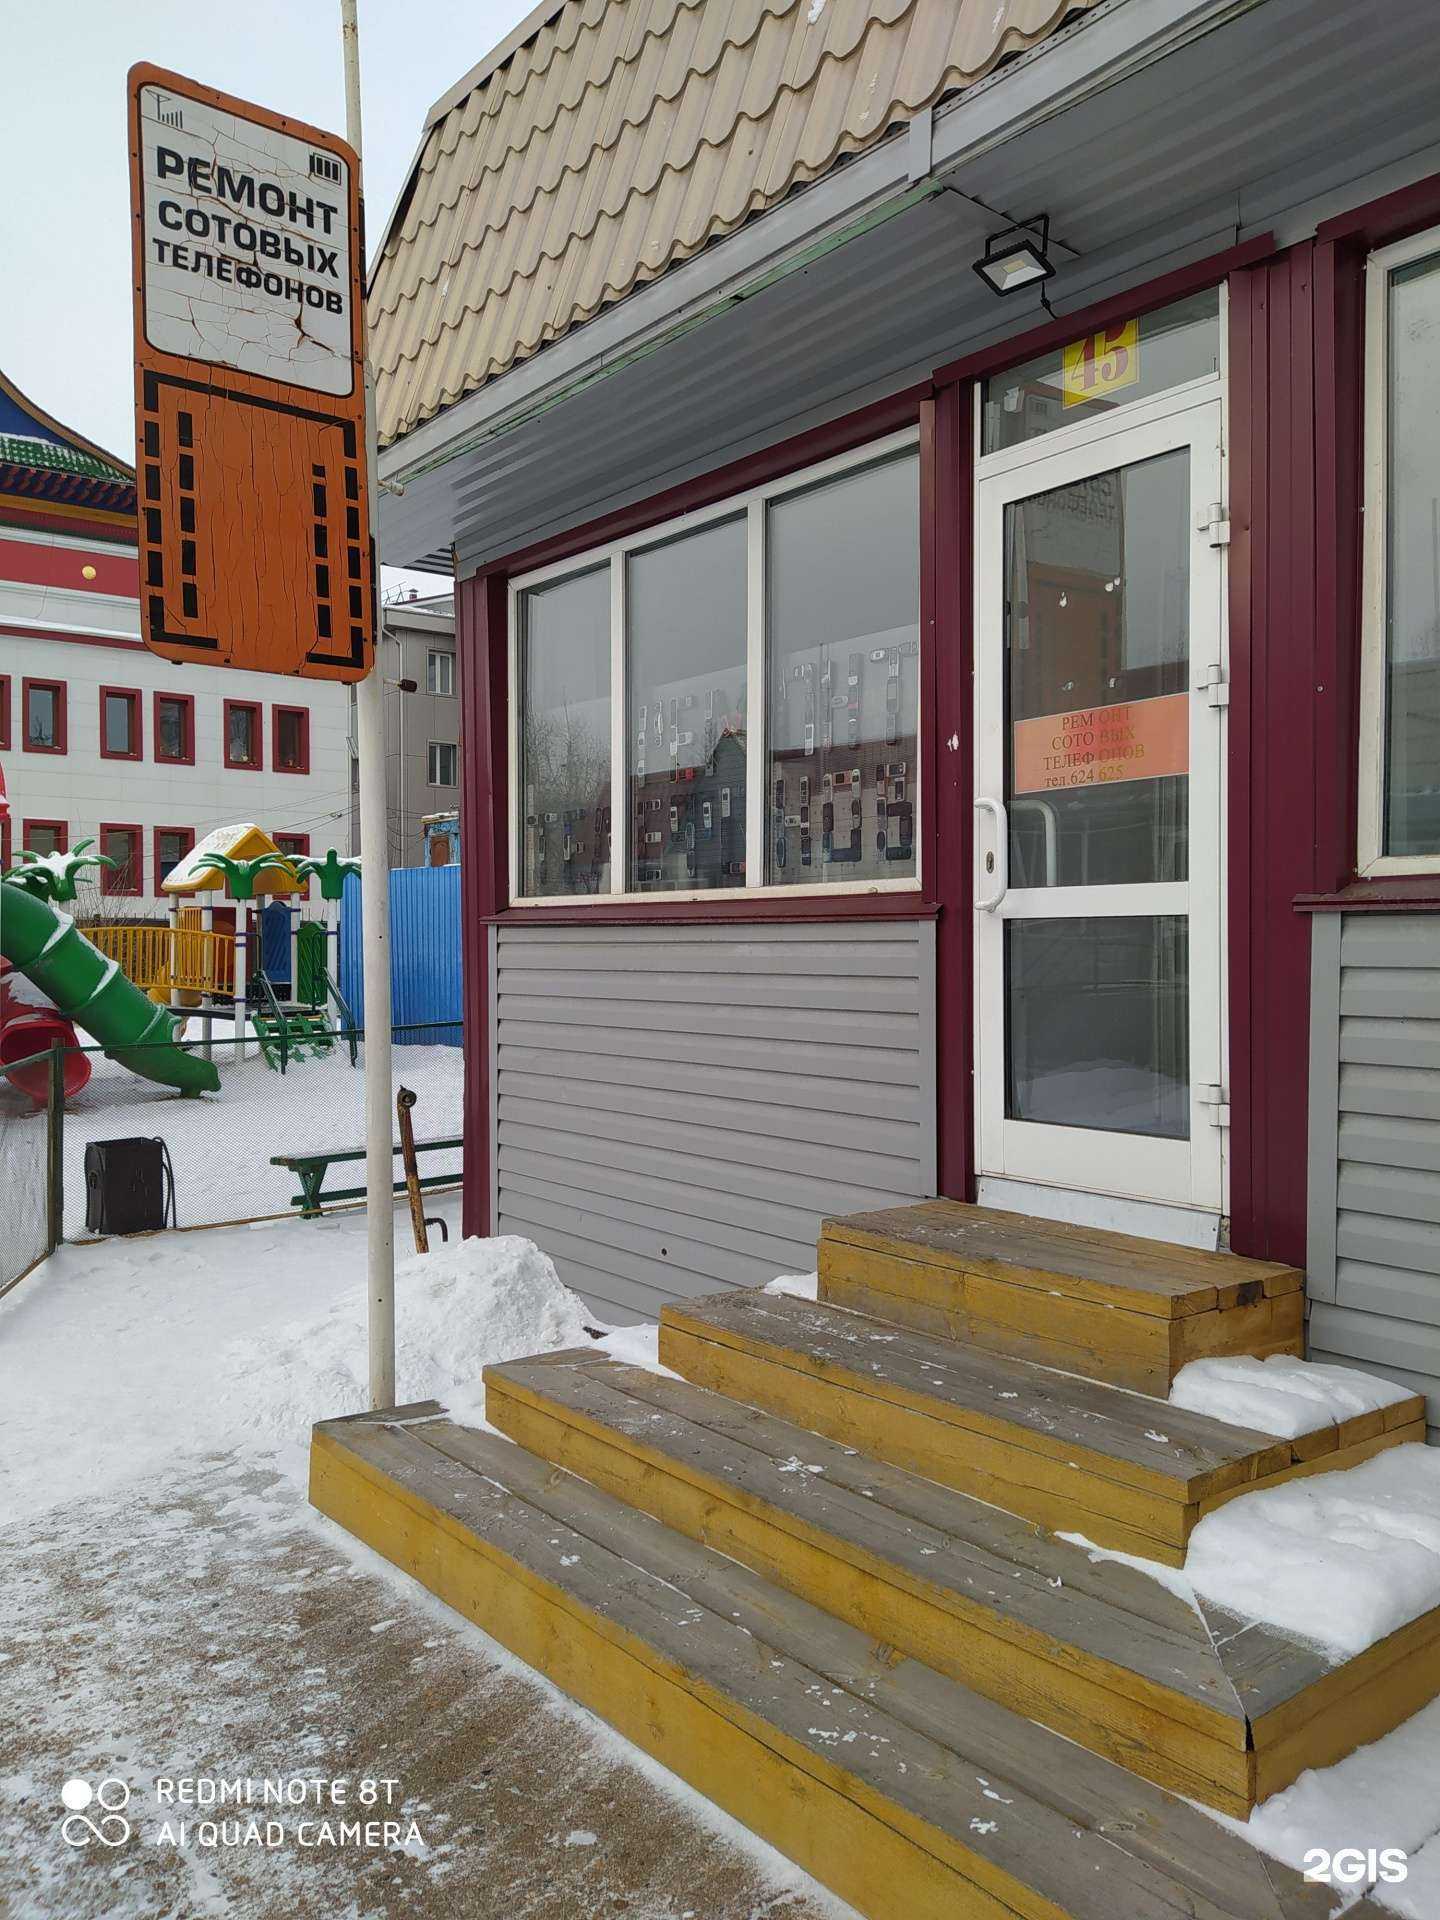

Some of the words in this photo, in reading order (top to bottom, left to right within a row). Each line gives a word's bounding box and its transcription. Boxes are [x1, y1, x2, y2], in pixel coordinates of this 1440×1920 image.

[156, 145, 338, 235] РЕМОНТ
[152, 237, 343, 315] ТЕЛЕФОНОВ
[158, 199, 339, 279] СОТОВЫХ
